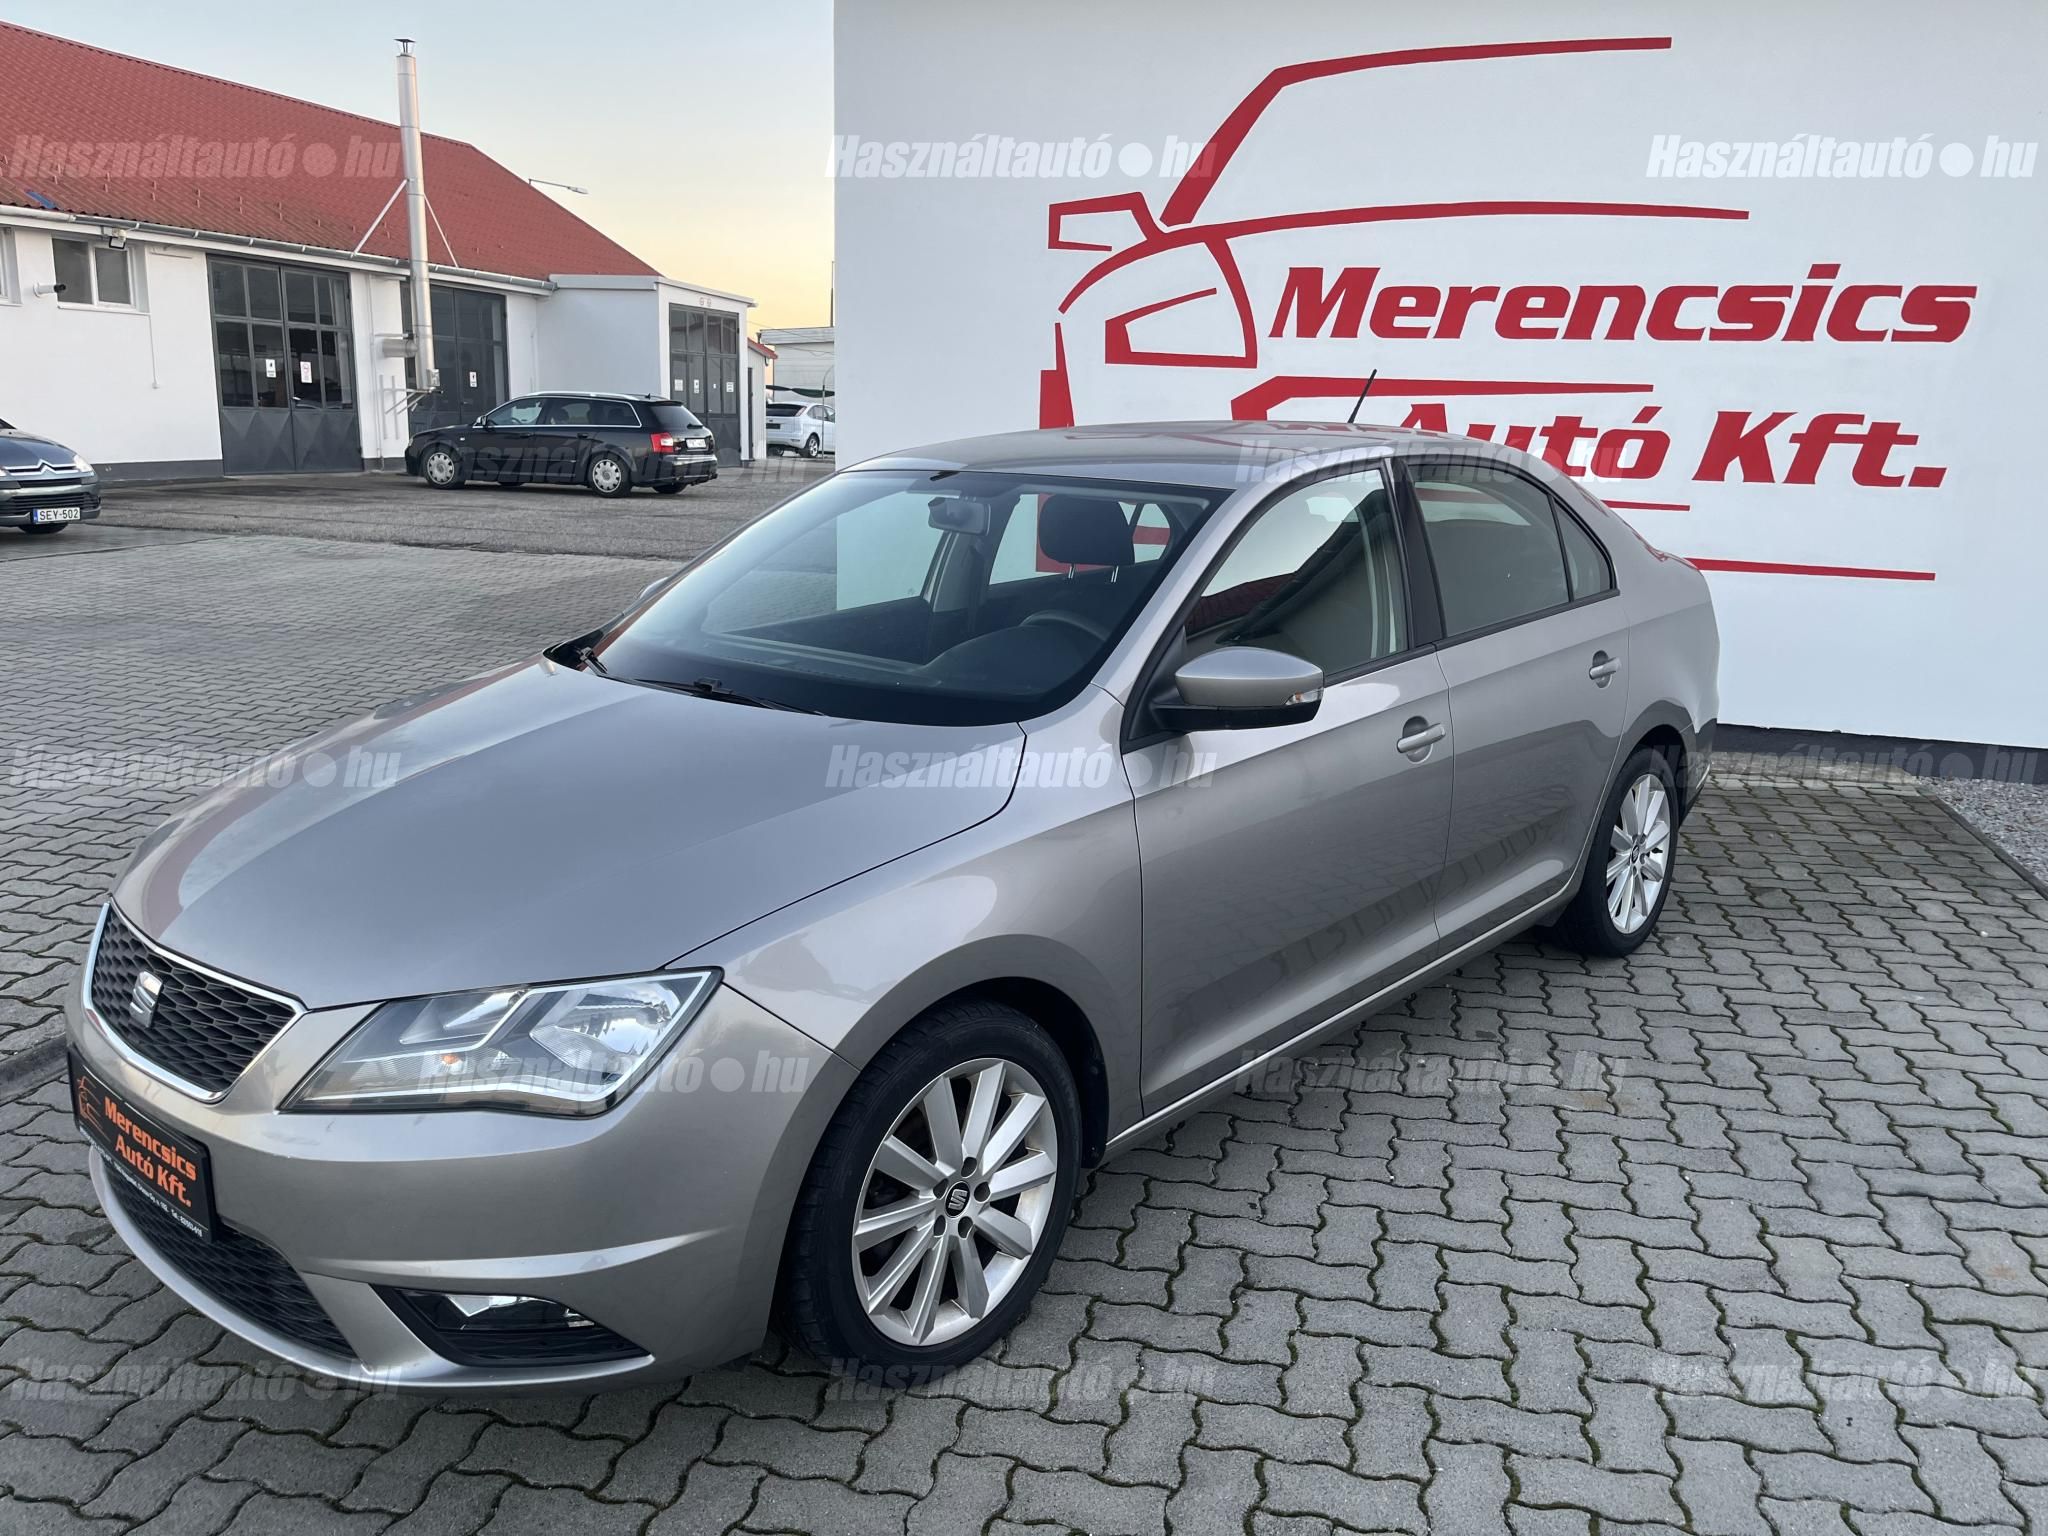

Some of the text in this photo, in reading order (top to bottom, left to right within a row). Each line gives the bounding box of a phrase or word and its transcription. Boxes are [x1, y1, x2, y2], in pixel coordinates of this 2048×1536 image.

[1269, 263, 1977, 343] Merencsics
[1691, 410, 1947, 488] Kft.
[39, 509, 79, 521] SEY-502
[104, 1095, 197, 1181] Merencsics
[115, 1134, 154, 1180] Autó
[157, 1165, 192, 1208] Kft.
